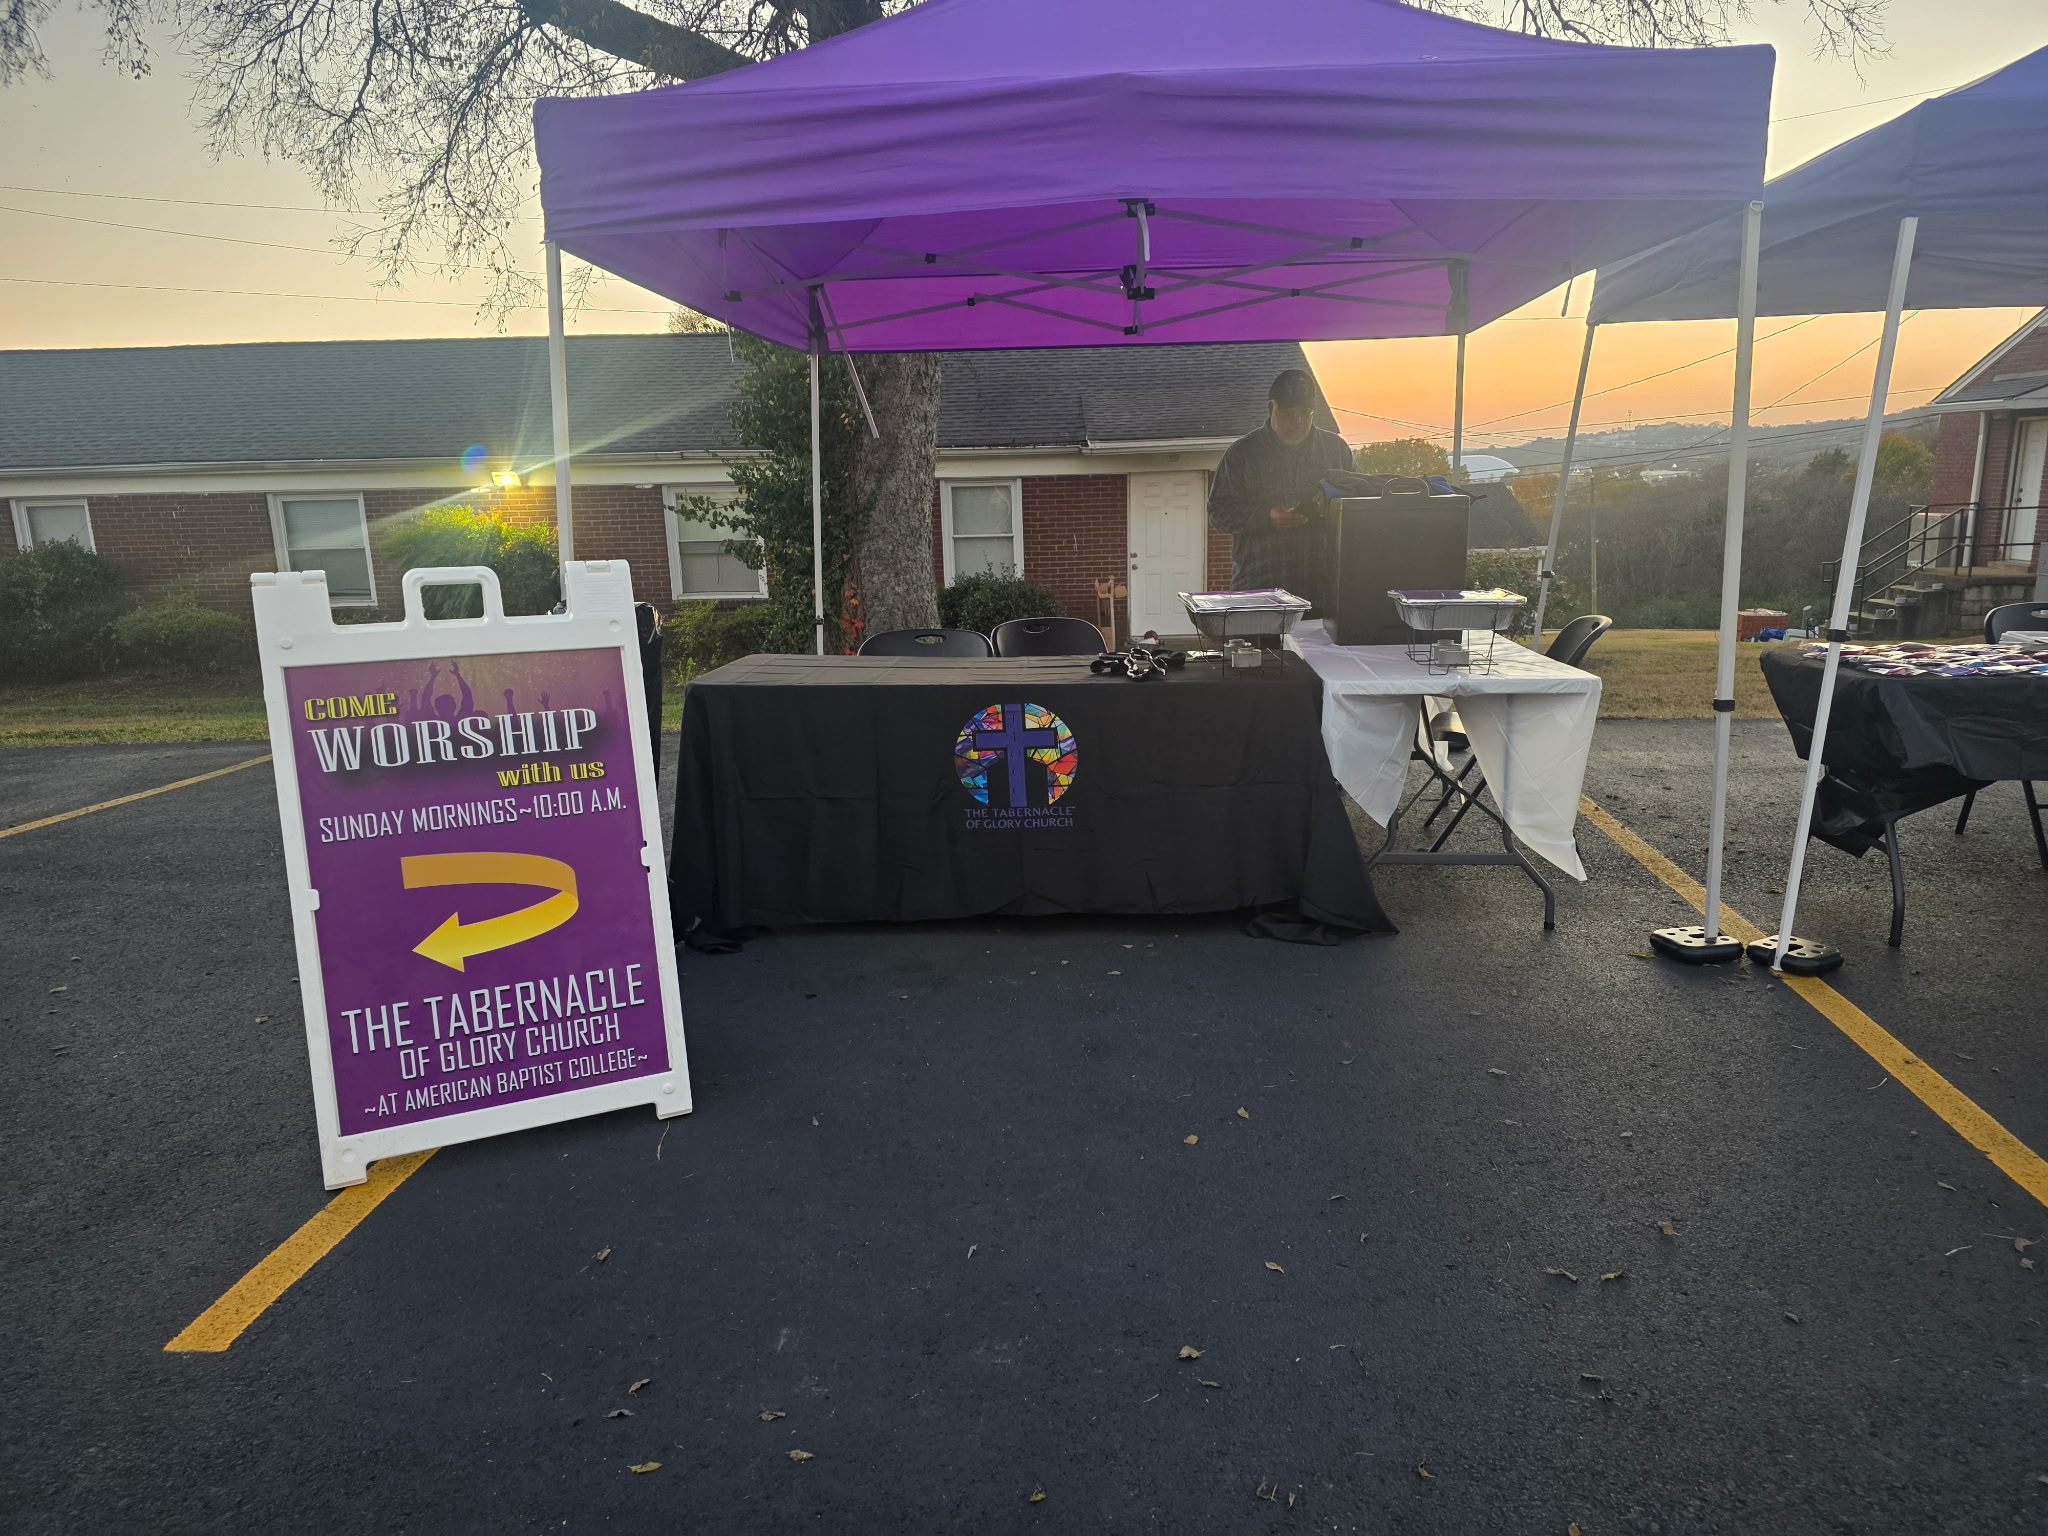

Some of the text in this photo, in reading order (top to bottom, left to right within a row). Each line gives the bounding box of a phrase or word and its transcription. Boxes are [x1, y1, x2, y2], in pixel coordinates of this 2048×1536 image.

[304, 693, 397, 721] COME
[307, 708, 597, 773] WORSHIP
[496, 760, 605, 787] with us
[320, 810, 403, 843] SUNDAY
[591, 787, 627, 813] A.M.
[965, 808, 988, 818] THE
[965, 817, 1073, 829] OF GLORY CHURCH
[341, 963, 645, 1054] THE TABERNACLE
[400, 1013, 621, 1080] OF GLORY CHURCH
[405, 1076, 492, 1112] AMERICAN
[497, 1061, 564, 1092] BAPTIST
